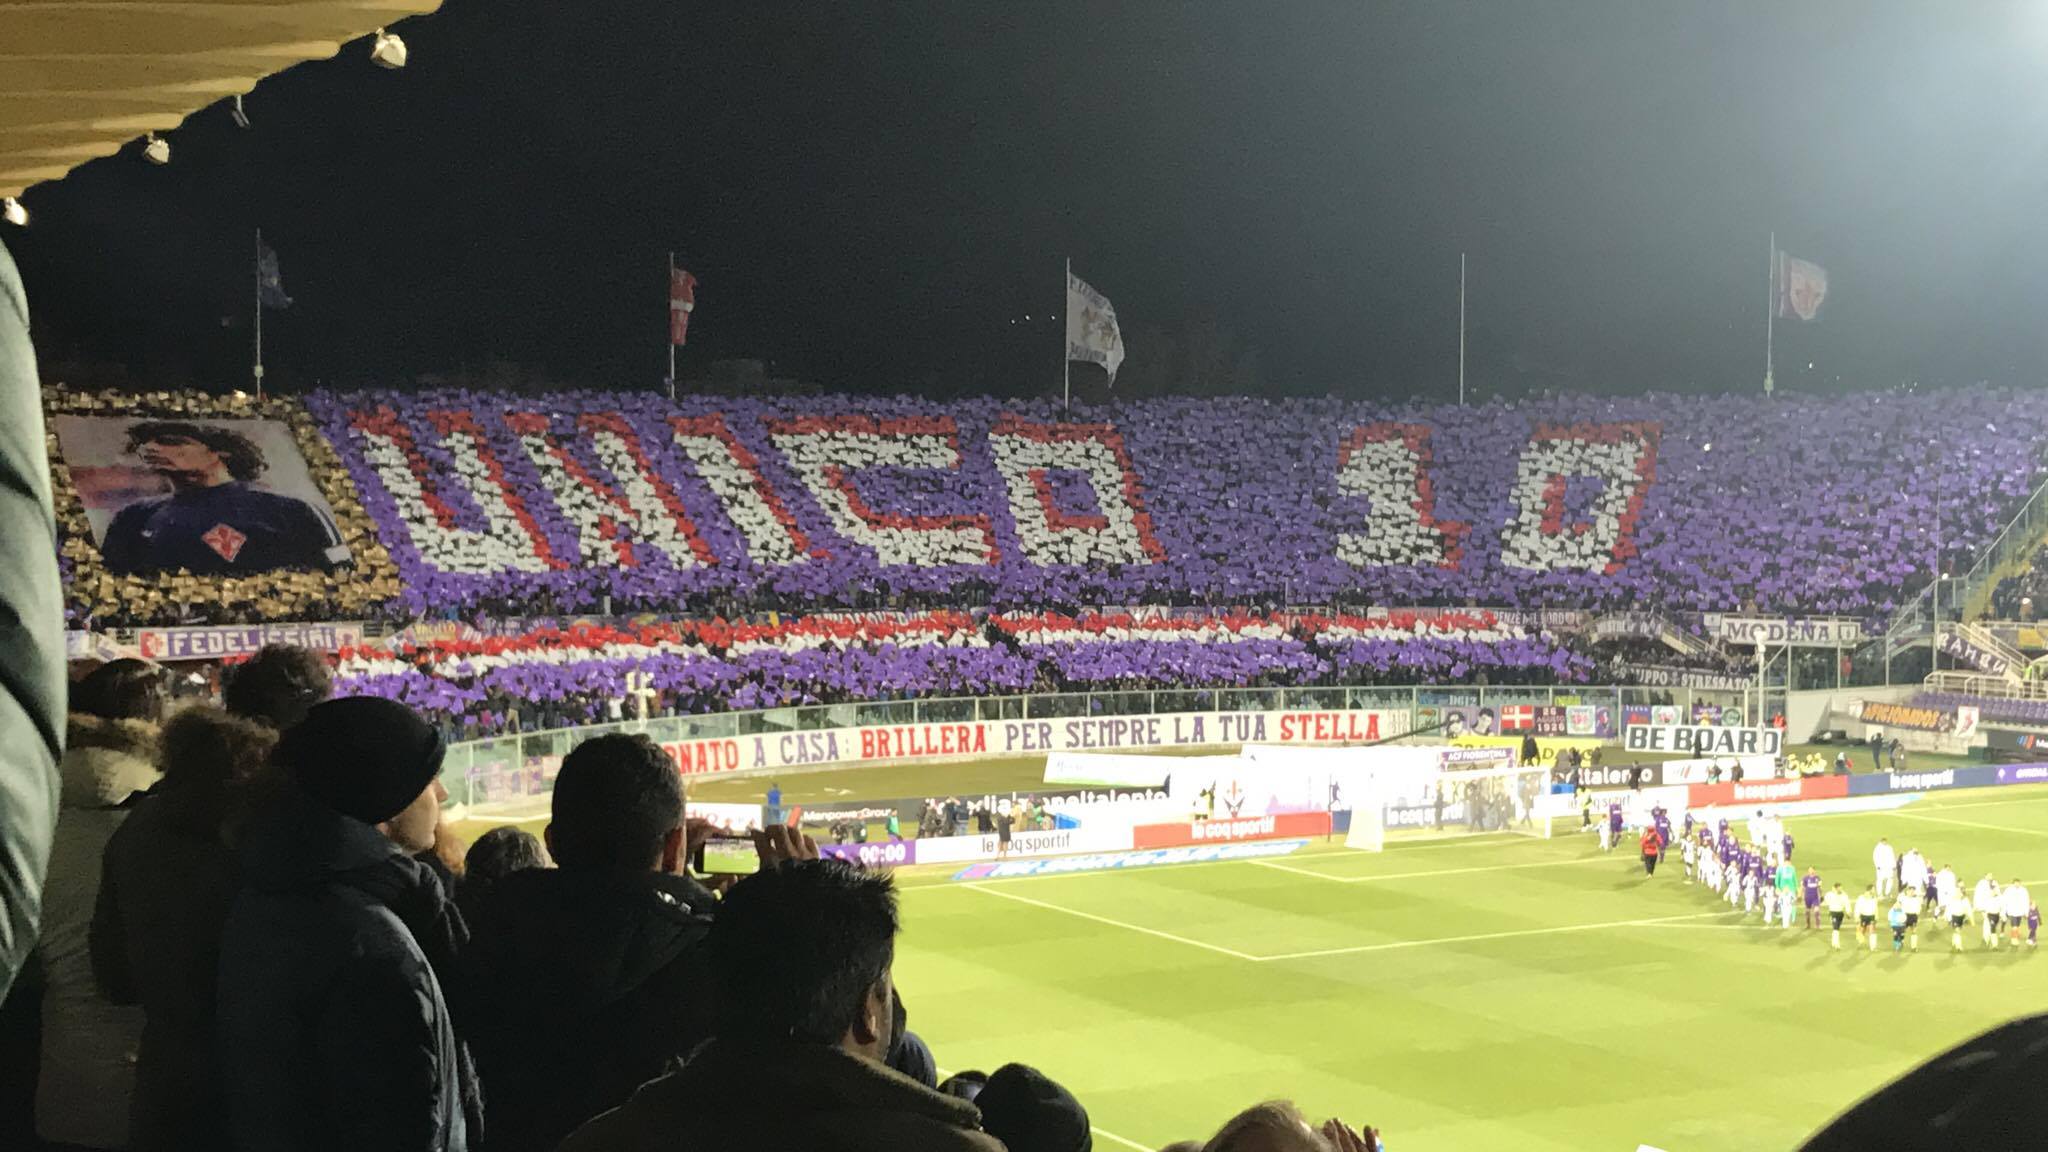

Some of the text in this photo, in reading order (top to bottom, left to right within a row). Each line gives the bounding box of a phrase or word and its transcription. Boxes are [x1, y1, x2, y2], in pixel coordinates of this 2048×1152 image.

[349, 408, 1661, 575] UNICO 10
[1726, 621, 1830, 641] MODENA
[753, 737, 766, 767] A
[1006, 722, 1052, 750] PER
[1065, 718, 1161, 749] SEMPRE
[1174, 716, 1211, 744] LA
[1219, 714, 1268, 742] TUA
[1280, 713, 1381, 741] STELLA
[1628, 727, 1779, 754] BE BOARD
[859, 843, 906, 865] 00:00
[1026, 832, 1071, 853] sportif
